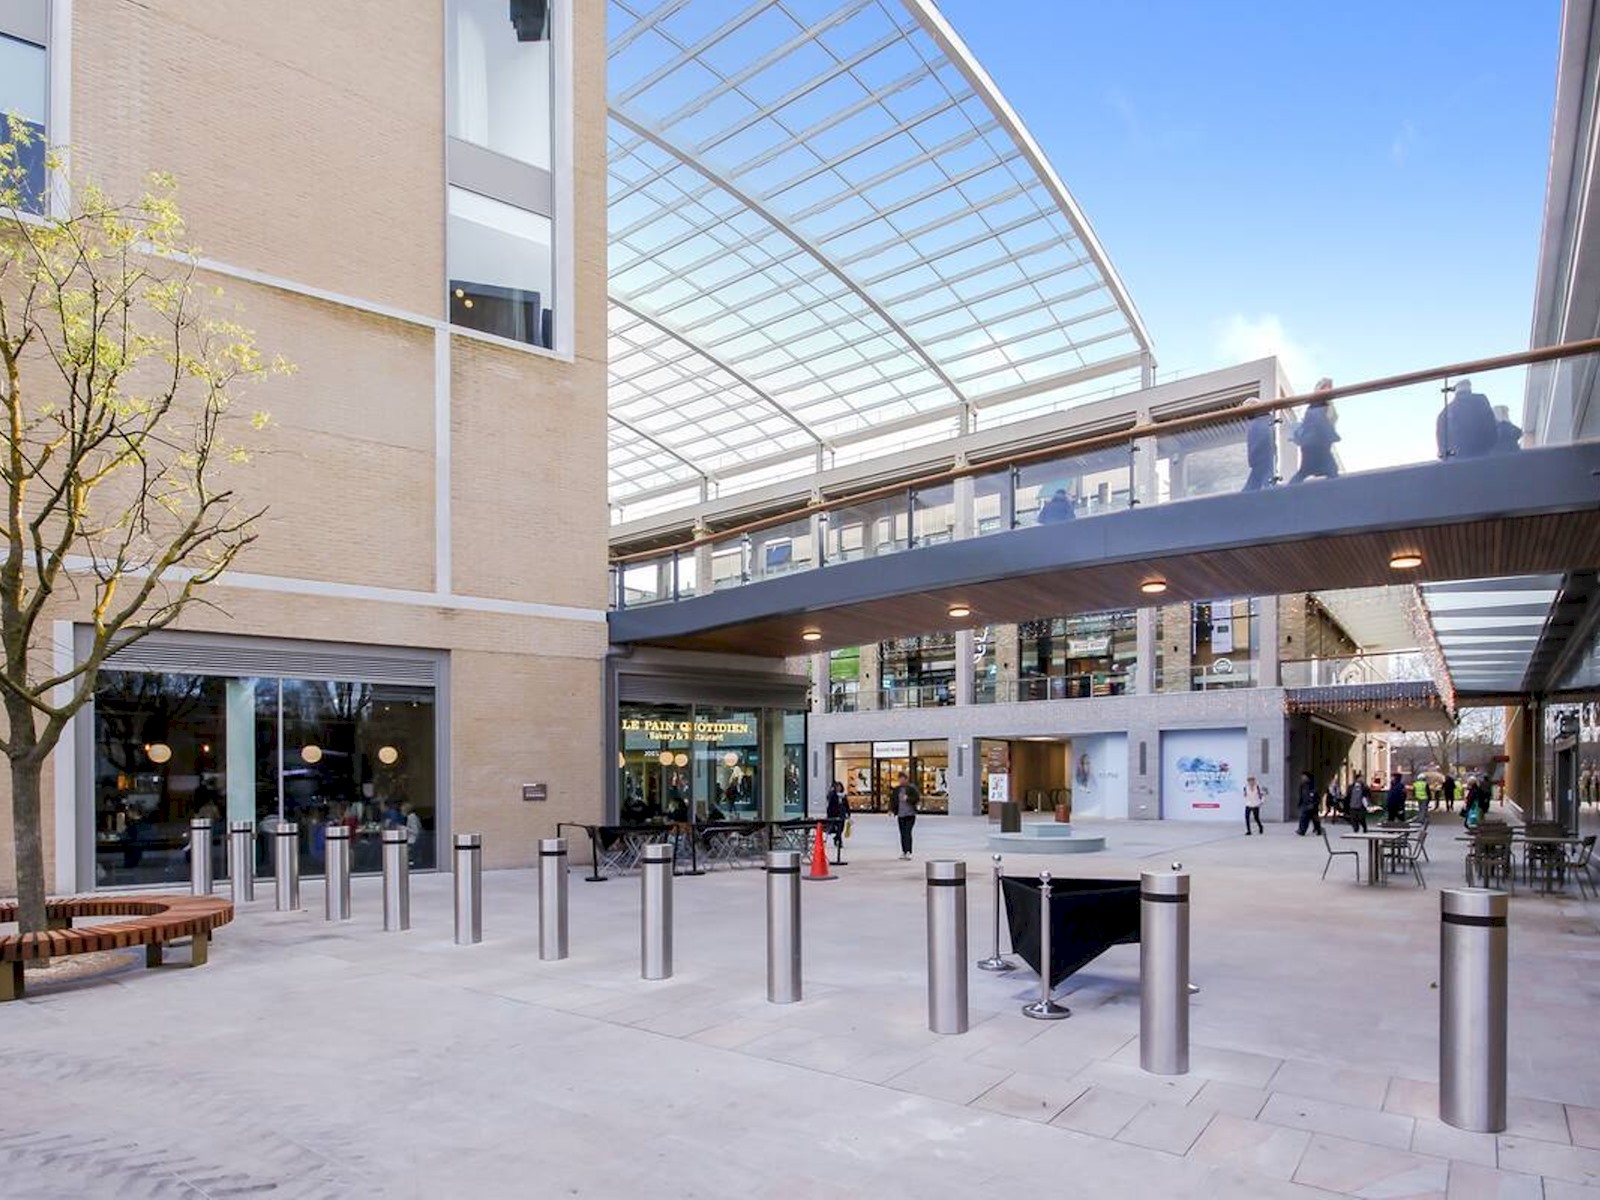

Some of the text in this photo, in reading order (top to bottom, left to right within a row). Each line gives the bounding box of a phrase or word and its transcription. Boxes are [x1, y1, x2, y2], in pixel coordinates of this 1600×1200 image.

[622, 719, 640, 730] LE
[645, 720, 674, 731] PAIN
[649, 731, 675, 742] Bakery
[684, 732, 724, 742] Rstaurant
